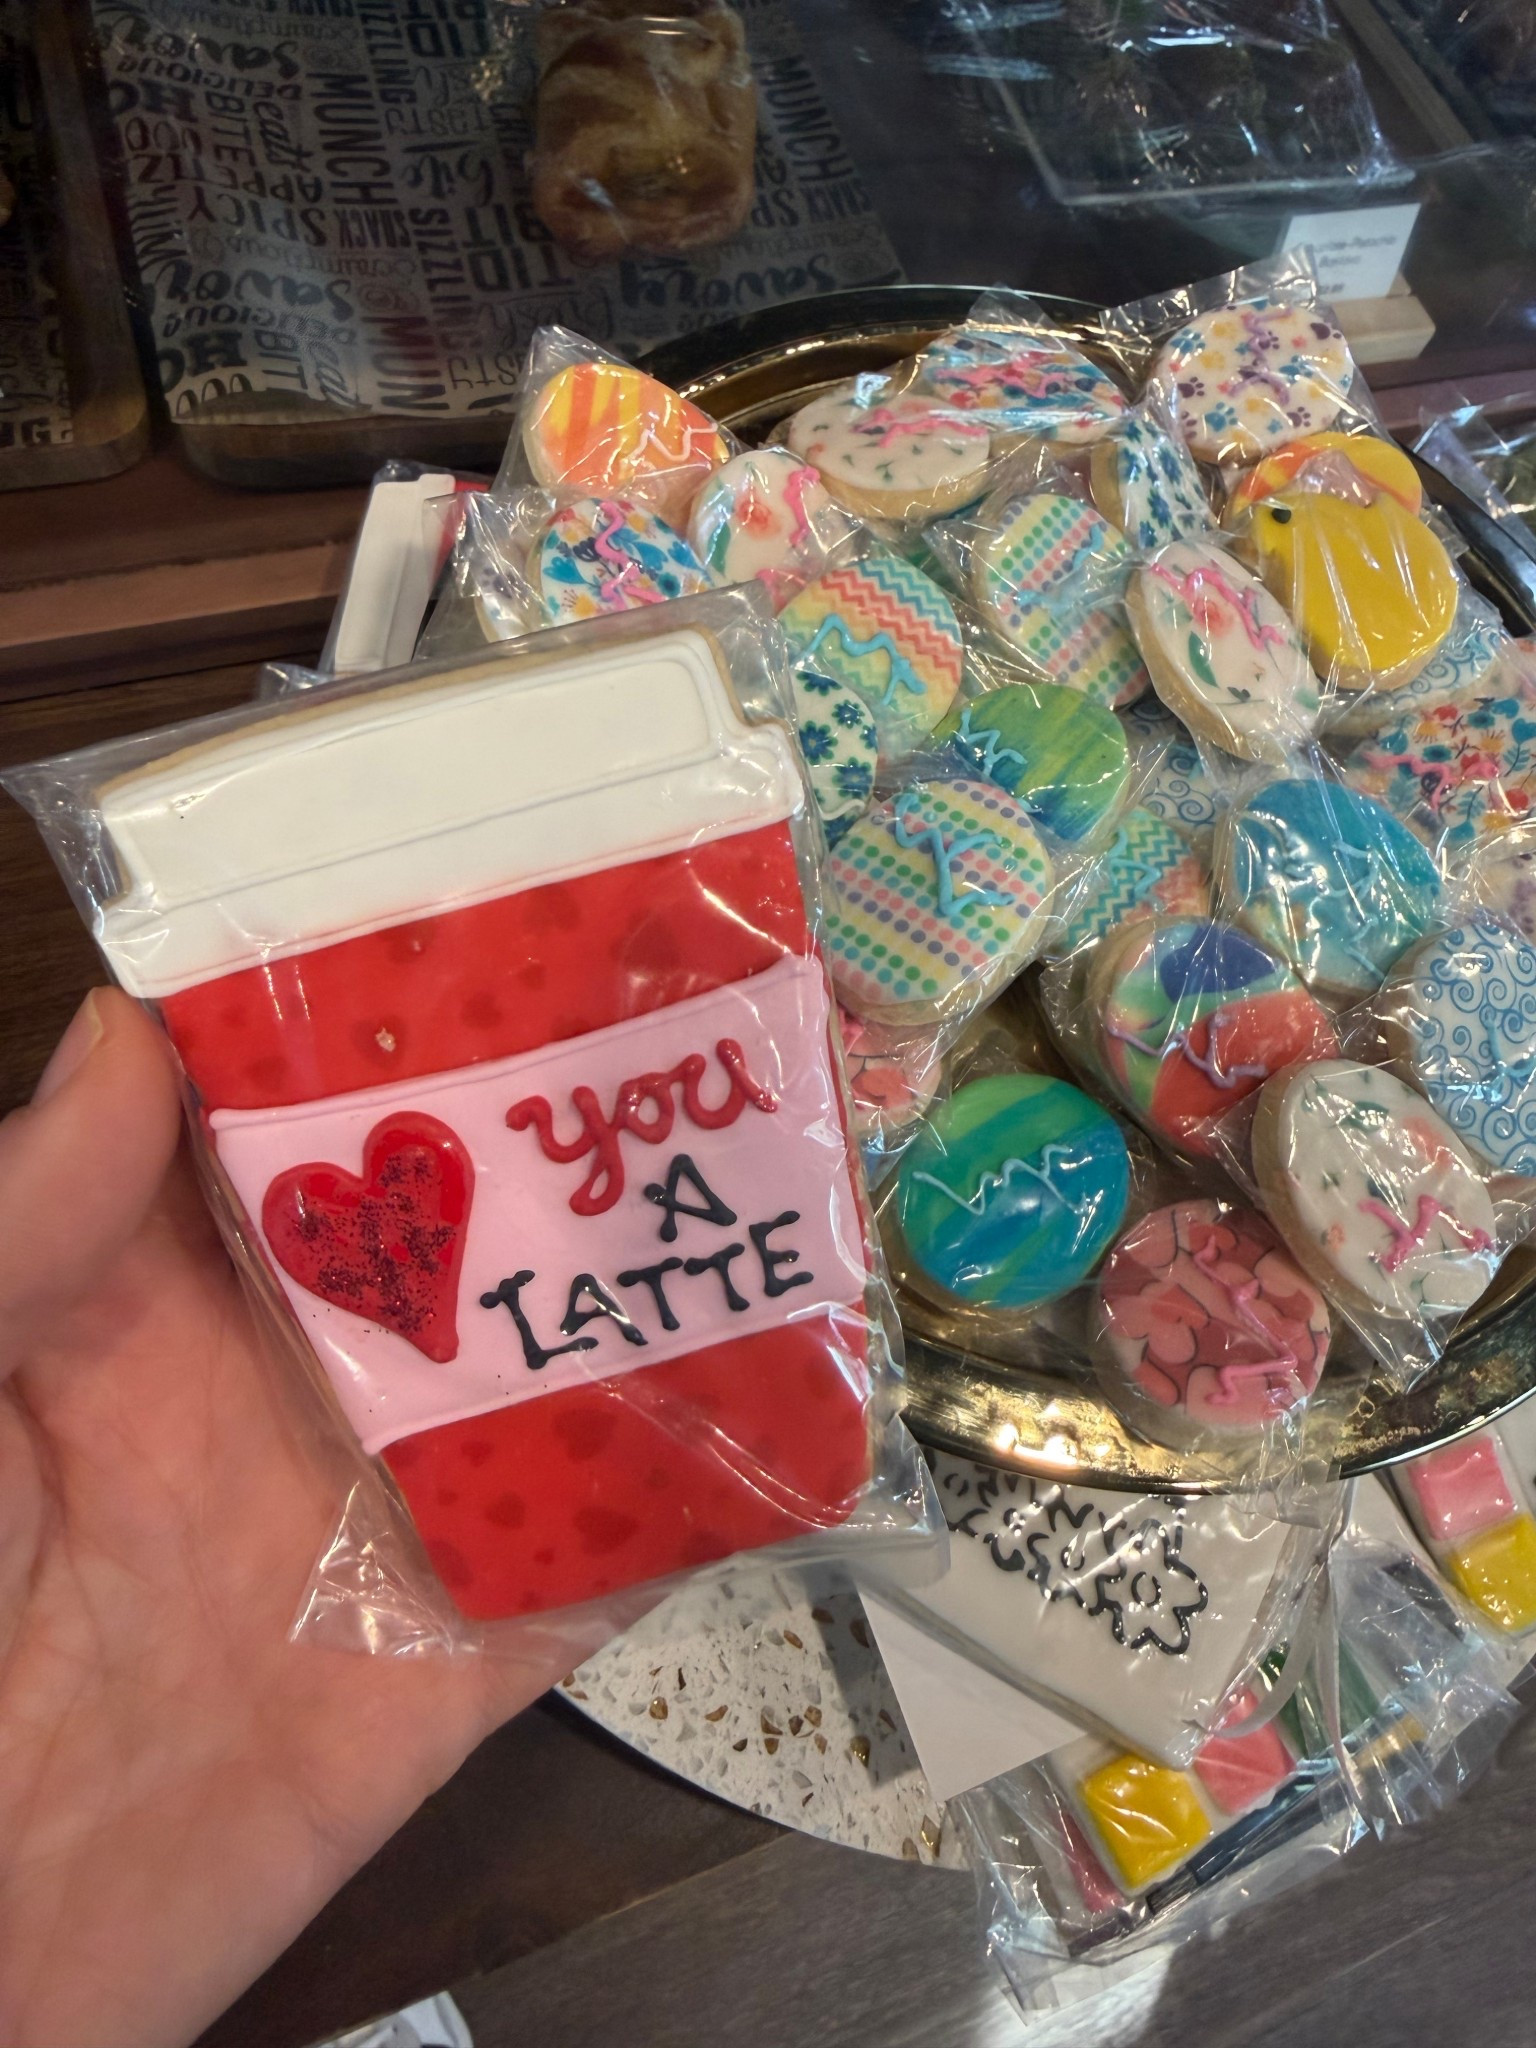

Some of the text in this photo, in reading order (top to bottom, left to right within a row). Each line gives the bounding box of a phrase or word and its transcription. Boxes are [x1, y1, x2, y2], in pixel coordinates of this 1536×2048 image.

[206, 91, 257, 167] BITE
[305, 73, 399, 204] MUNCH
[188, 185, 327, 247] SPICY
[333, 209, 411, 248] SNACK
[505, 1038, 778, 1216] you
[644, 1154, 737, 1242] A
[480, 1211, 814, 1369] LATTE
